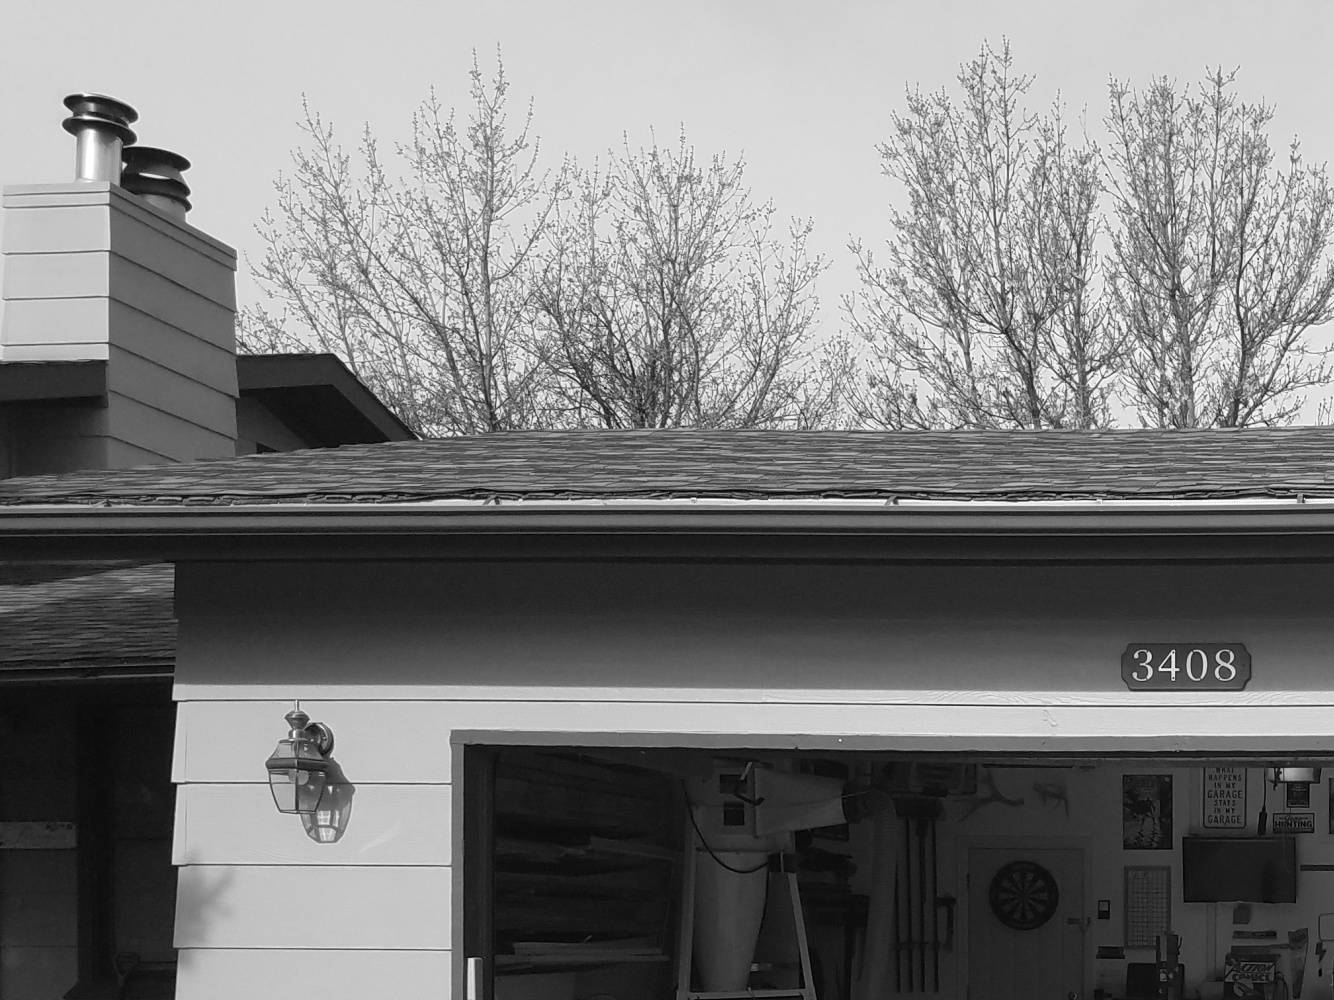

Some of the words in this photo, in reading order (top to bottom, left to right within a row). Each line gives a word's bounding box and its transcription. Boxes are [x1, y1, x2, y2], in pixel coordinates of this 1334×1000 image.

[1132, 649, 1236, 681] 3408
[1208, 774, 1242, 782] HAPPENS
[1207, 790, 1243, 799] GARAGE
[1214, 799, 1236, 807] STAYS
[1207, 815, 1242, 825] GARAGE
